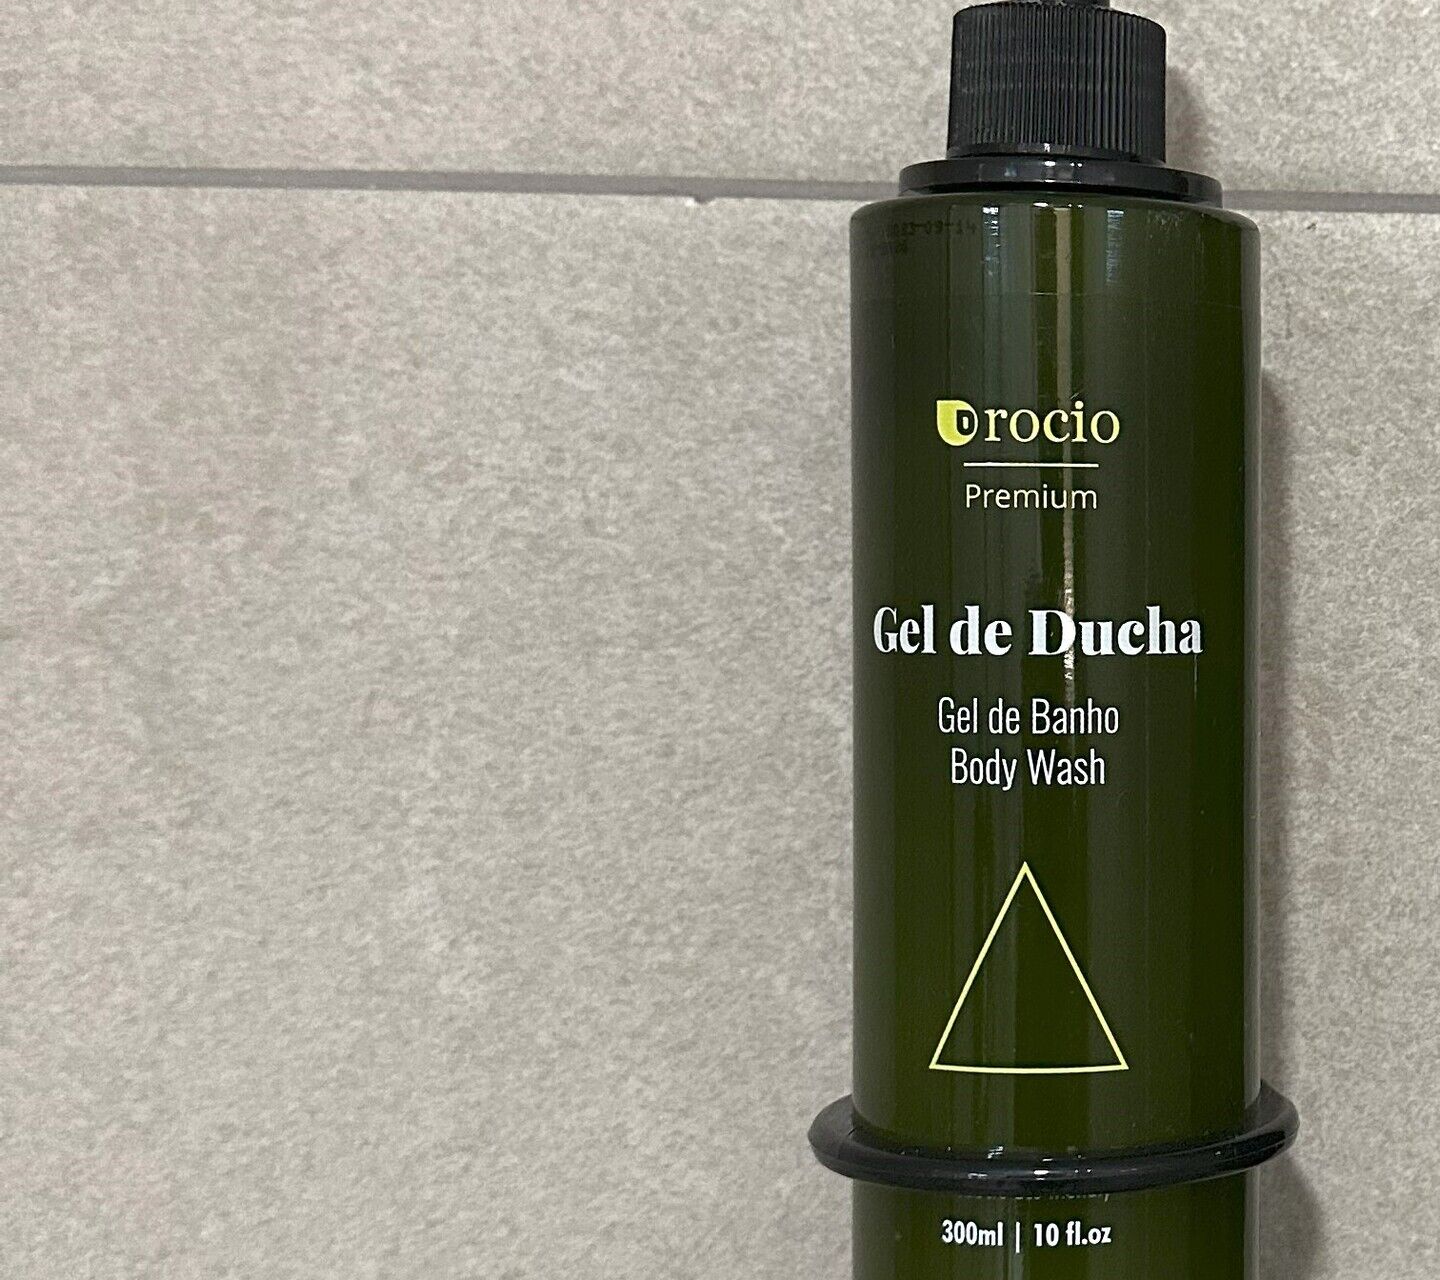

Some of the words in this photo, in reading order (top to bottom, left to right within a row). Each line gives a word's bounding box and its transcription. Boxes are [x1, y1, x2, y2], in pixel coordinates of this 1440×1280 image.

[965, 483, 1098, 510] Premium
[873, 605, 937, 654] Gel
[949, 606, 1013, 656] de
[1028, 605, 1204, 656] Ducha
[938, 696, 979, 734] Gel
[988, 697, 1021, 735] de
[1031, 697, 1120, 735] Banho
[951, 747, 1018, 792] Body
[1026, 748, 1106, 786] Wash
[941, 1219, 1004, 1247] 300ml
[1033, 1222, 1060, 1247] 10
[1065, 1220, 1112, 1246] fl.oz
